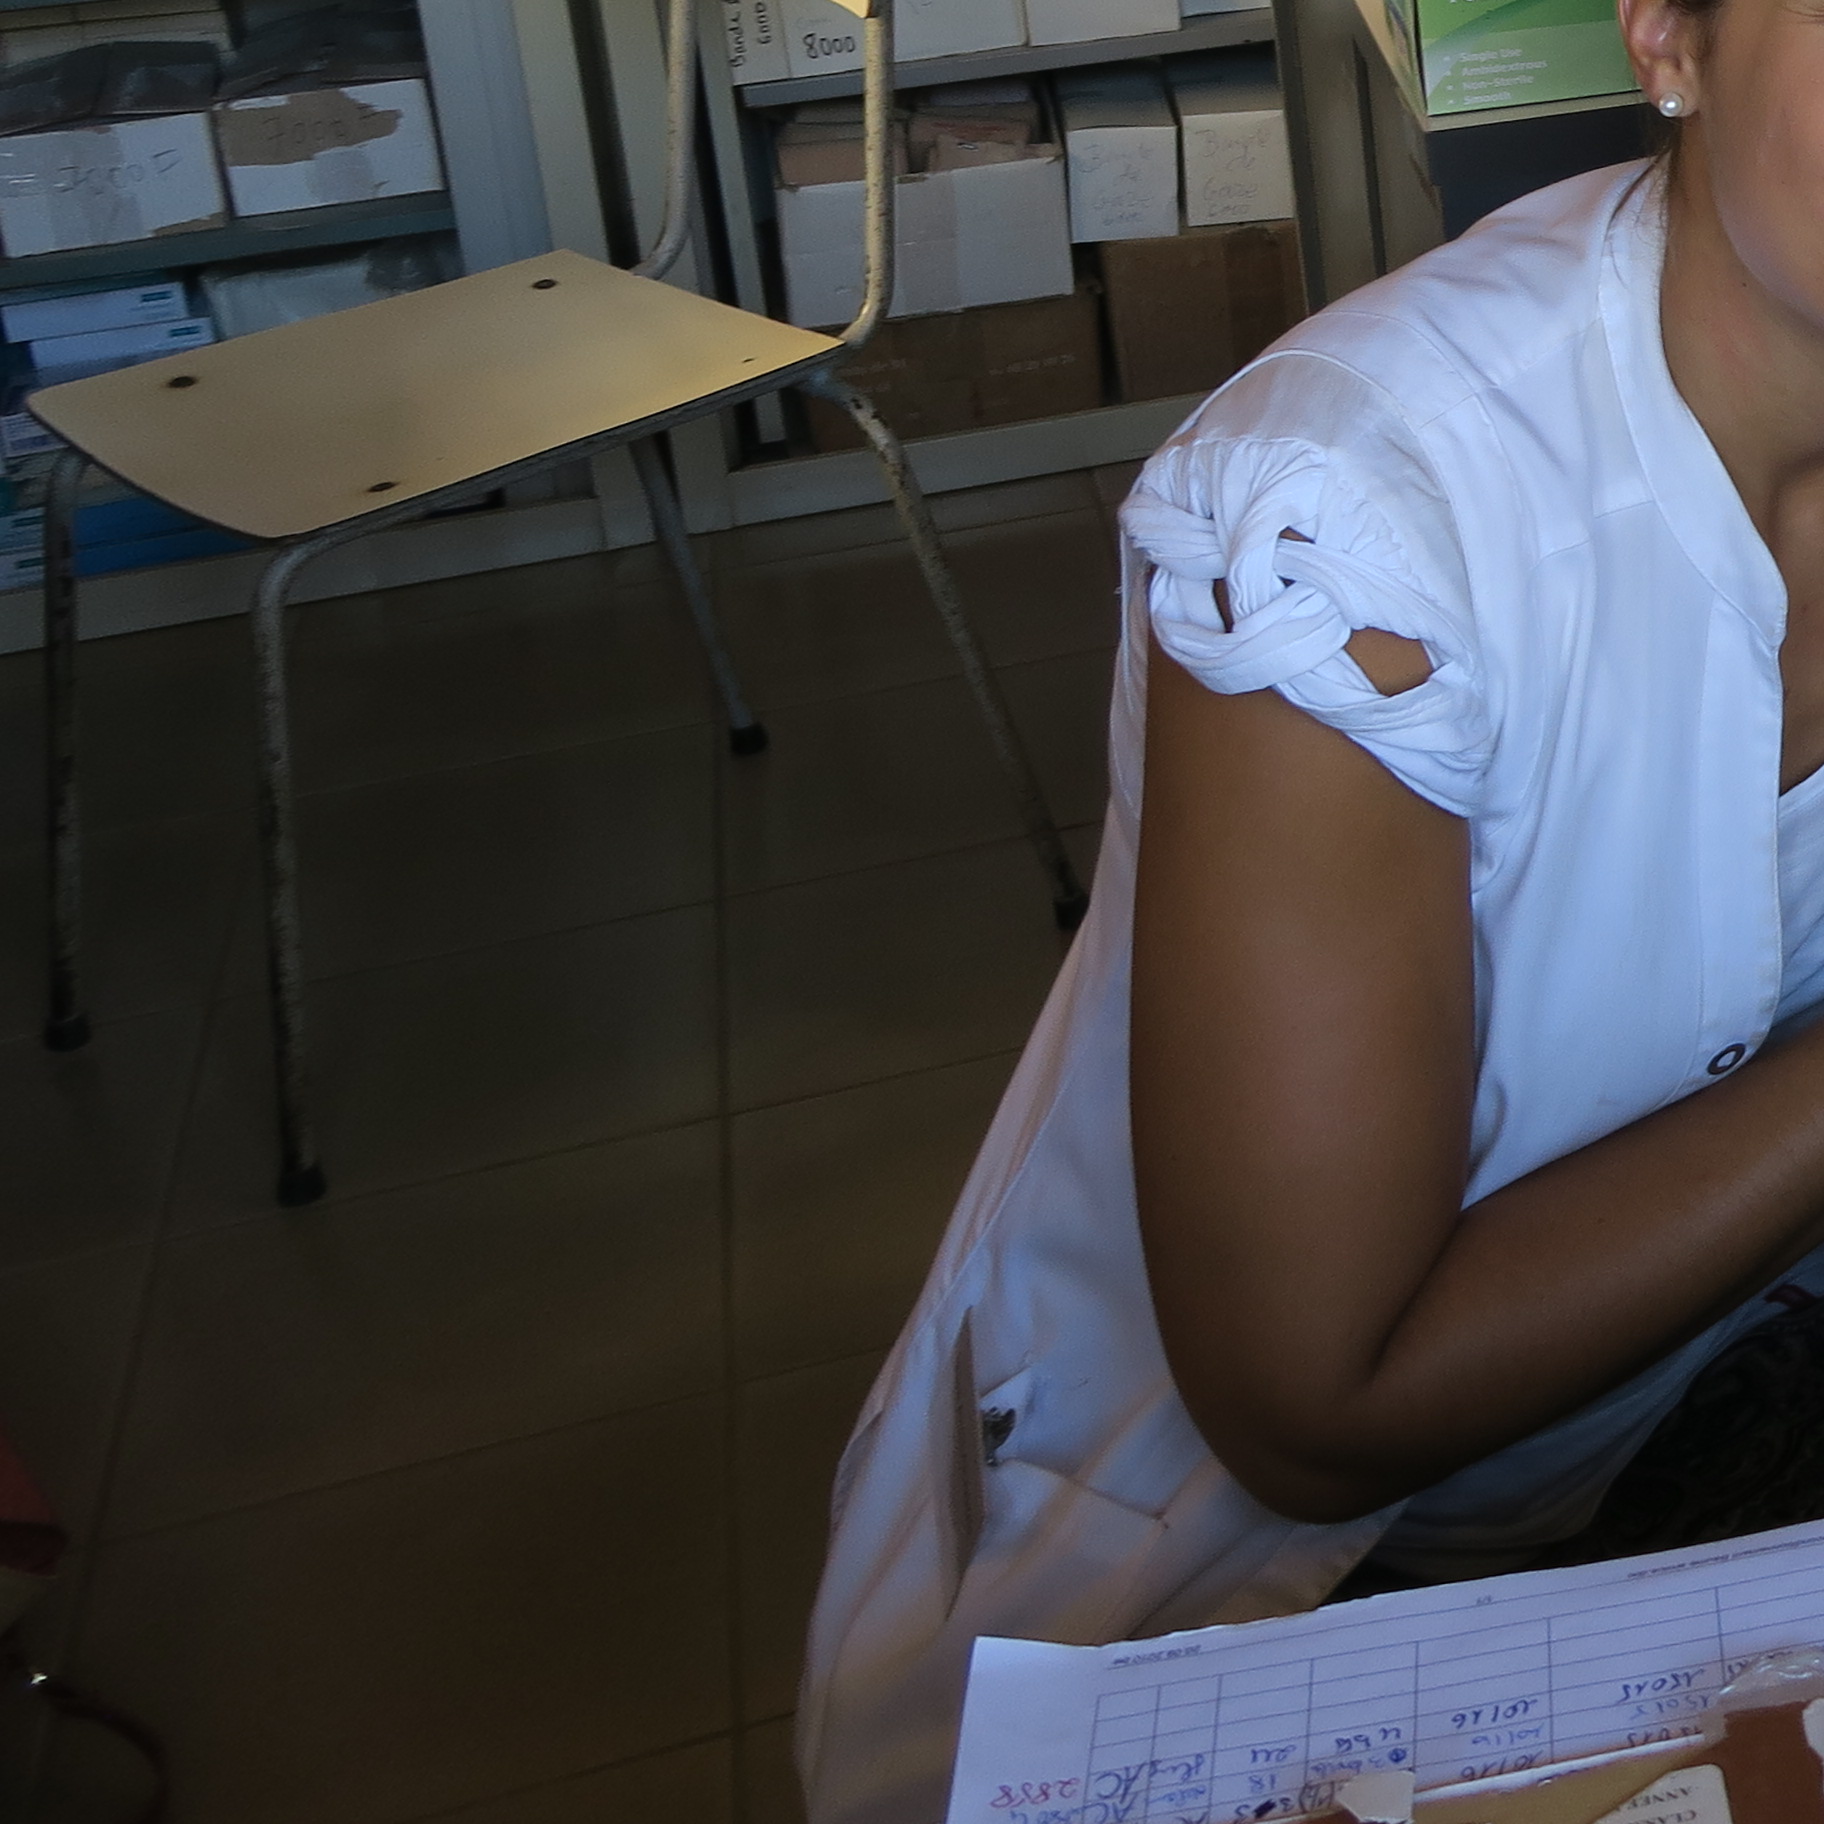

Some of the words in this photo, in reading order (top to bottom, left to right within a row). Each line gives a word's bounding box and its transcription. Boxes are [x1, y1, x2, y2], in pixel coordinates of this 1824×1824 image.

[803, 33, 856, 59] 8000
[1462, 60, 1547, 76] Ambidextrous
[1464, 75, 1534, 90] Non-Sterile
[1464, 91, 1511, 105] Smooth
